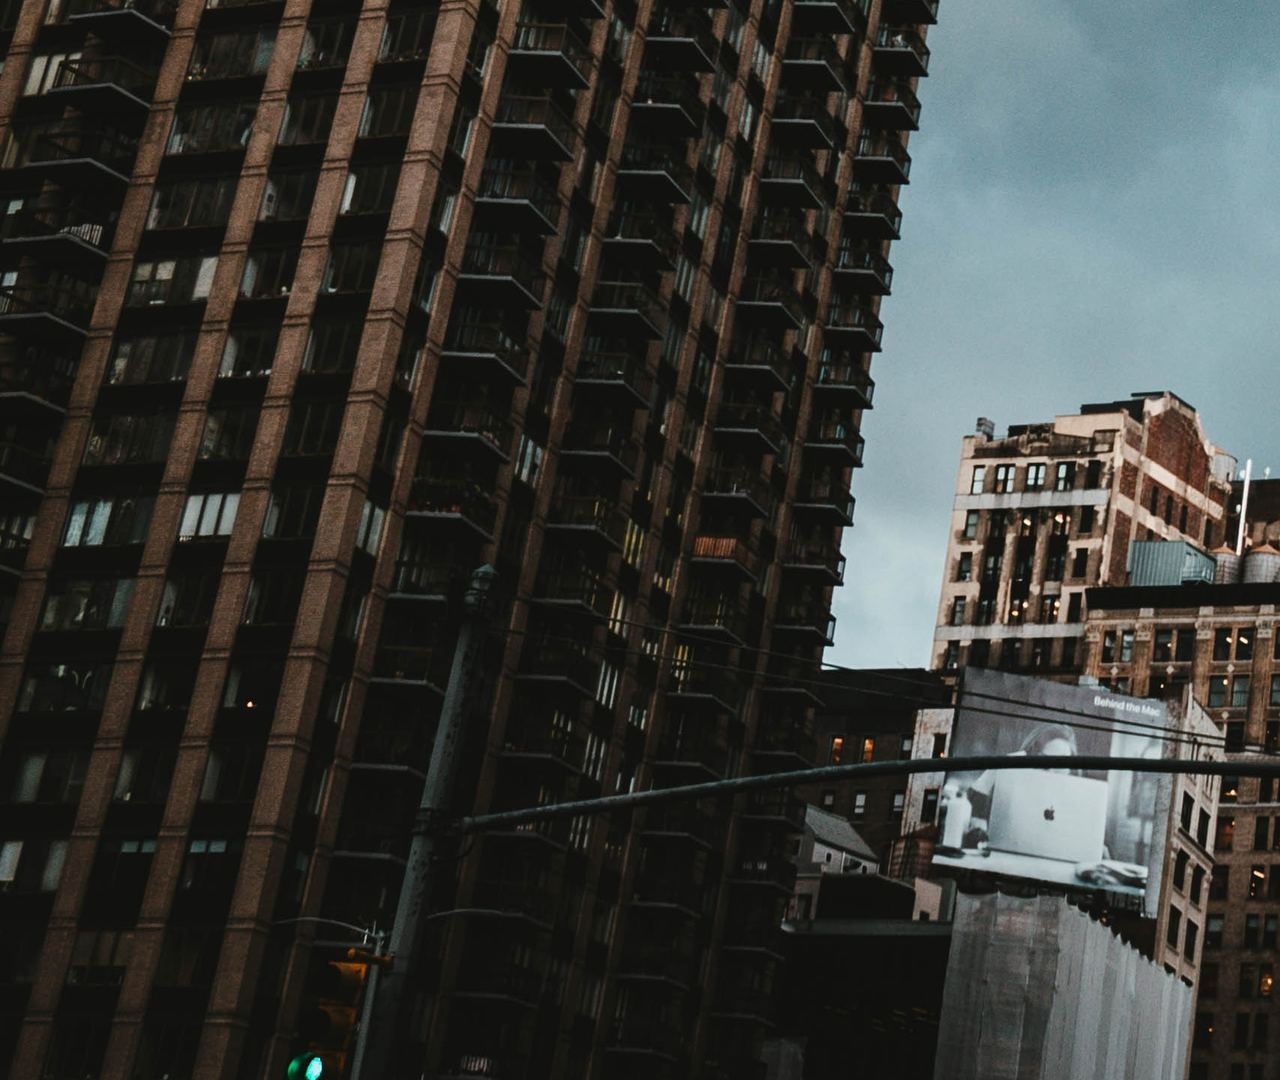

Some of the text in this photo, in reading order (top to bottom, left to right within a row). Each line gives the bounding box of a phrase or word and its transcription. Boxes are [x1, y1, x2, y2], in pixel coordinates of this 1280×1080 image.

[1094, 695, 1161, 717] Behind the Mac
